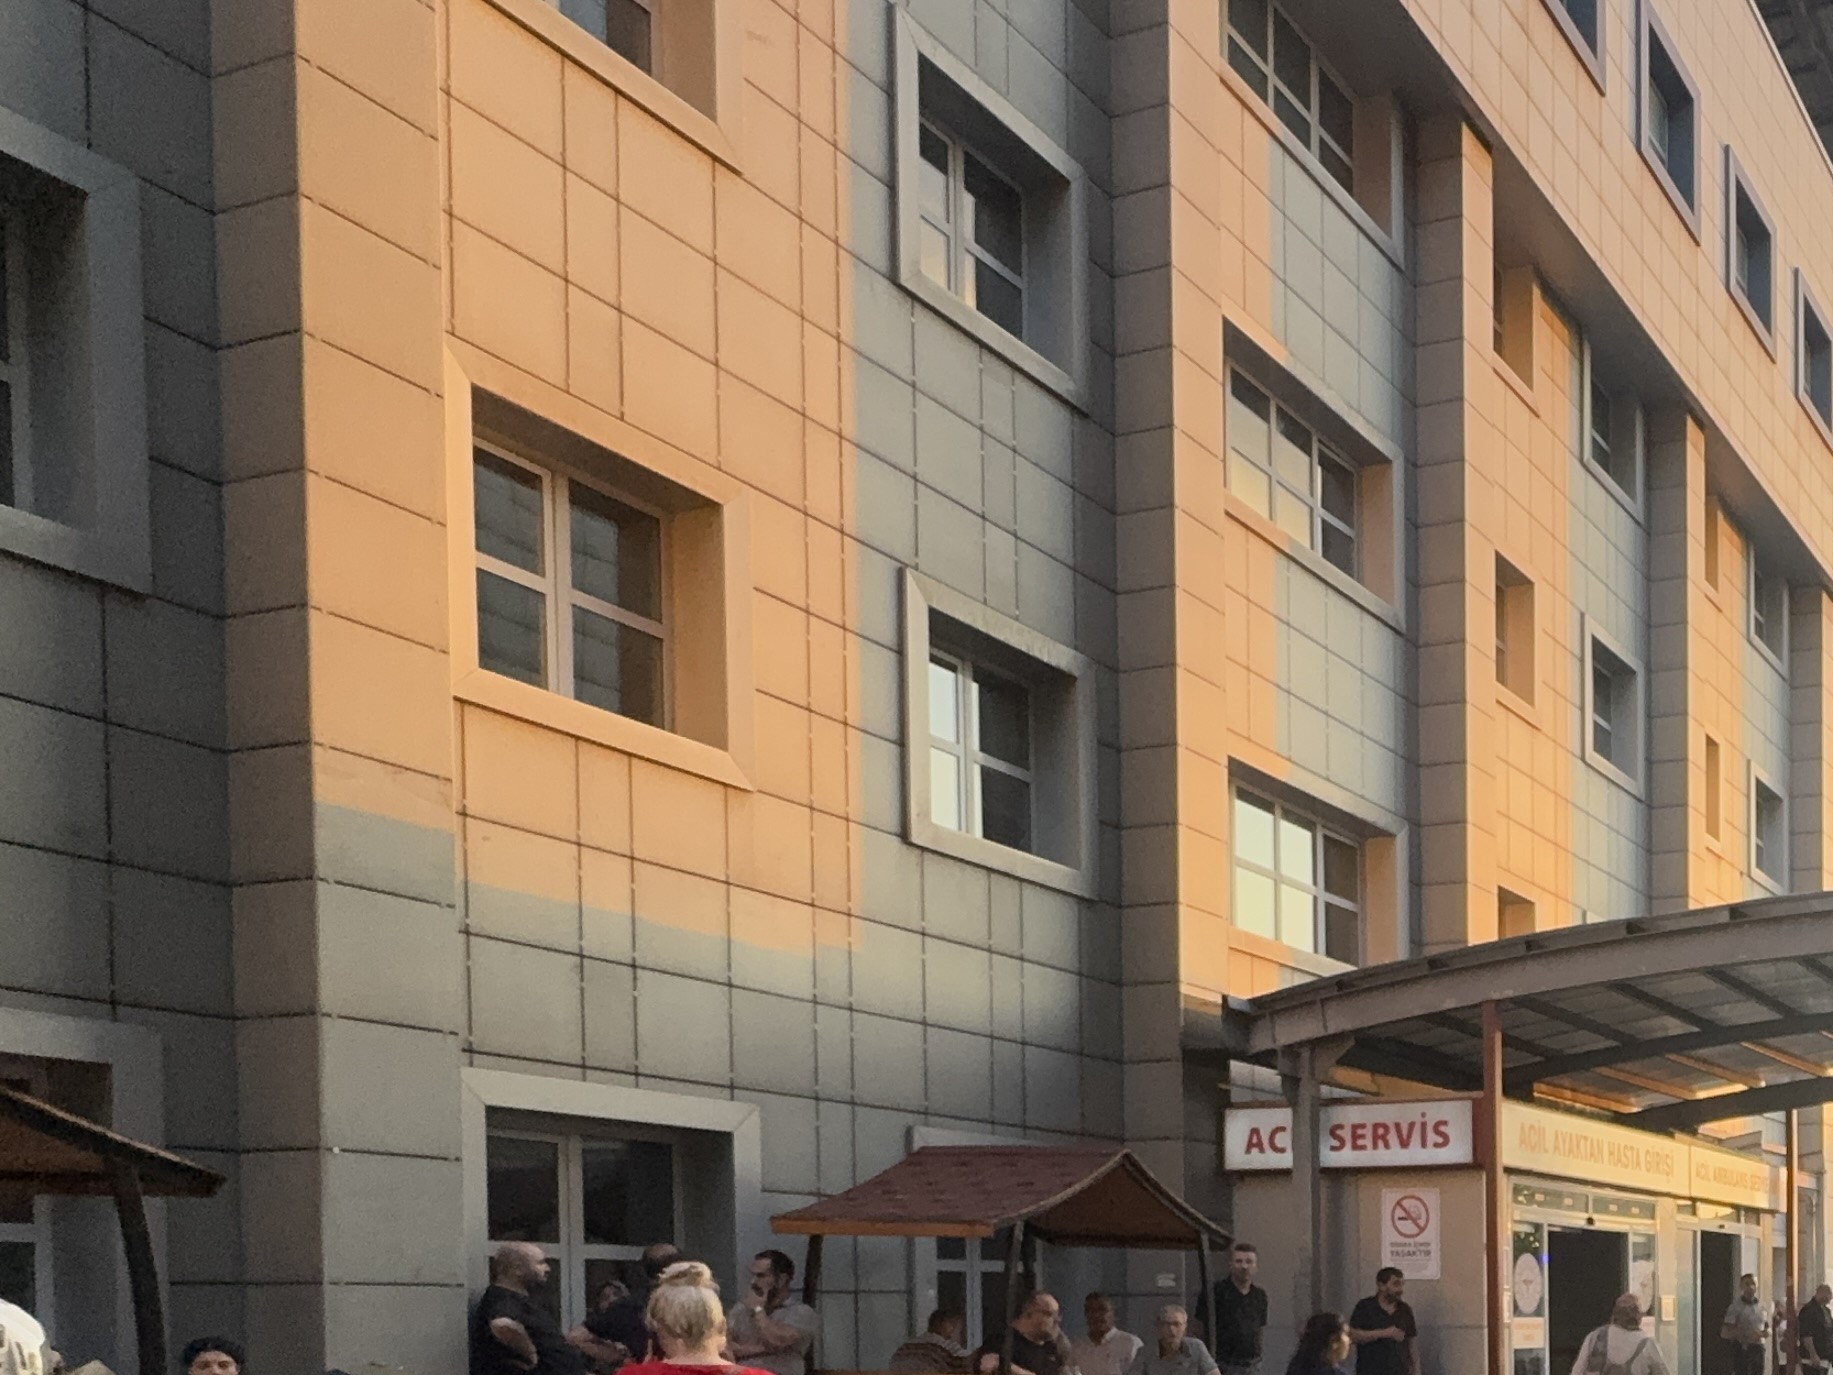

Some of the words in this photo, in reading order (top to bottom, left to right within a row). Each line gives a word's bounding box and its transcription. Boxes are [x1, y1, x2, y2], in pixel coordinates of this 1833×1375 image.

[1245, 1126, 1288, 1154] AC
[1328, 1111, 1451, 1152] SERVİS
[1552, 1129, 1605, 1165] AYAKTAN
[1608, 1140, 1642, 1172] HASTA
